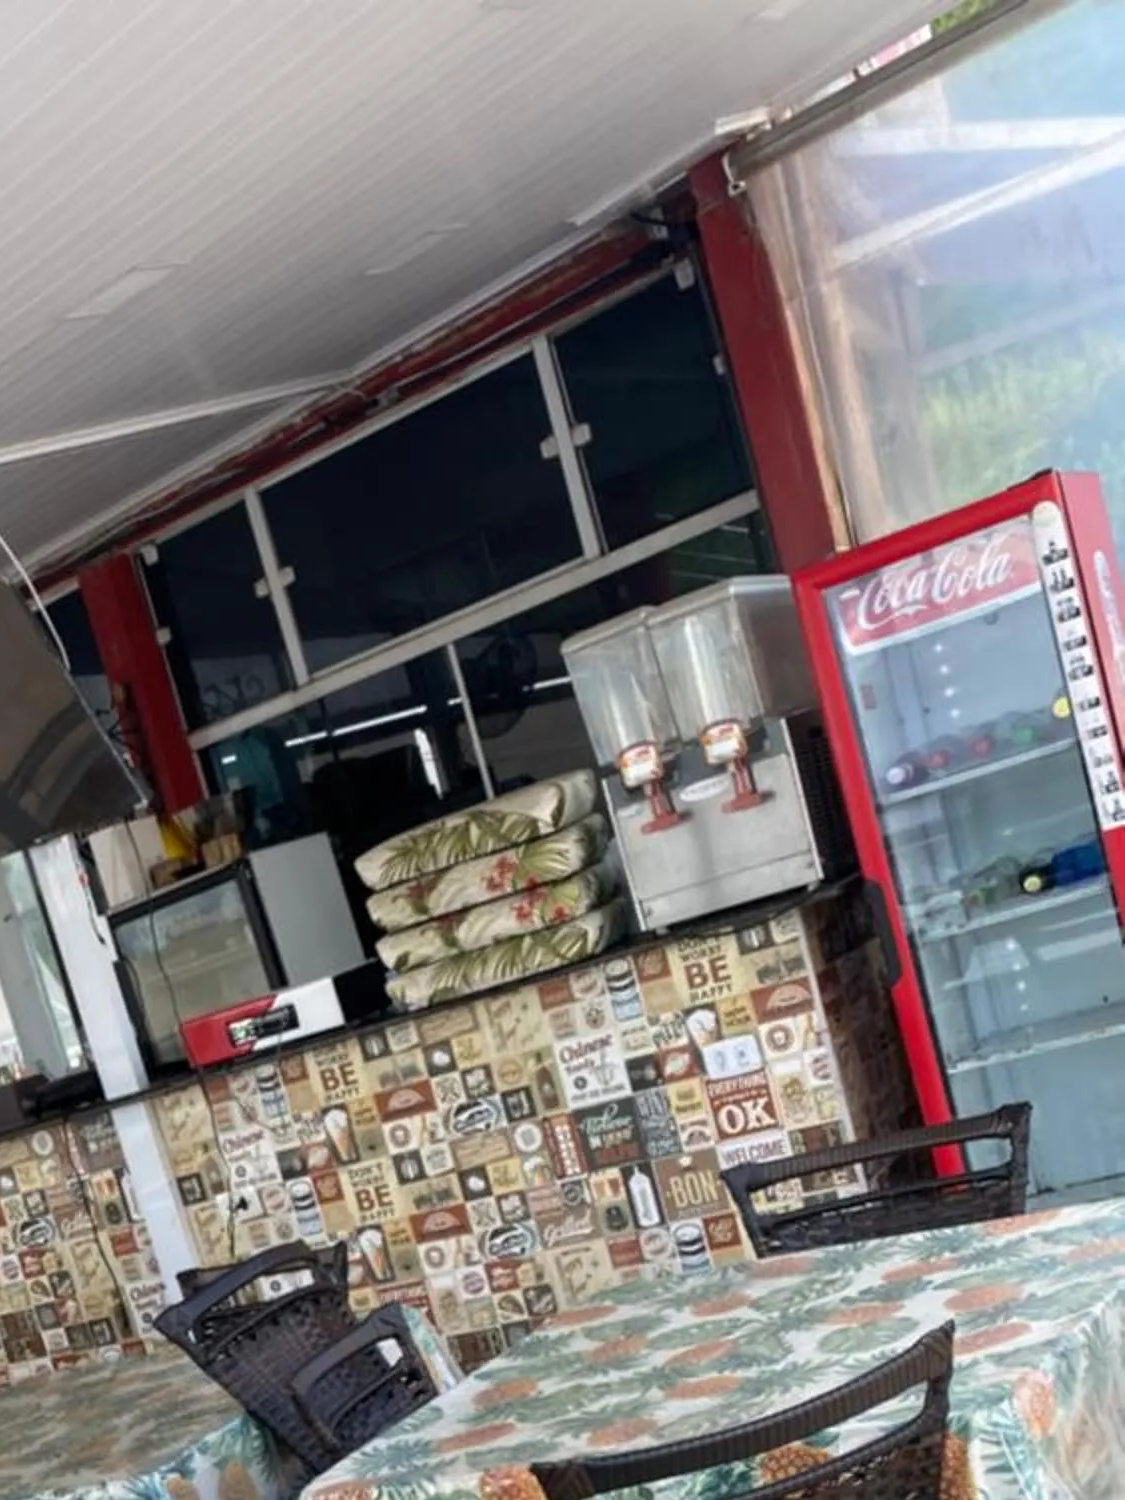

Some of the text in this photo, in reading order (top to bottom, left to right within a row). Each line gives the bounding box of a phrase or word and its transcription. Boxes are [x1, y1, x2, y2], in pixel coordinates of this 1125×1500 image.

[683, 955, 732, 990] BE
[319, 1061, 358, 1092] BE
[716, 1096, 778, 1135] OK
[355, 1183, 395, 1214] BE
[669, 1168, 719, 1208] BON
